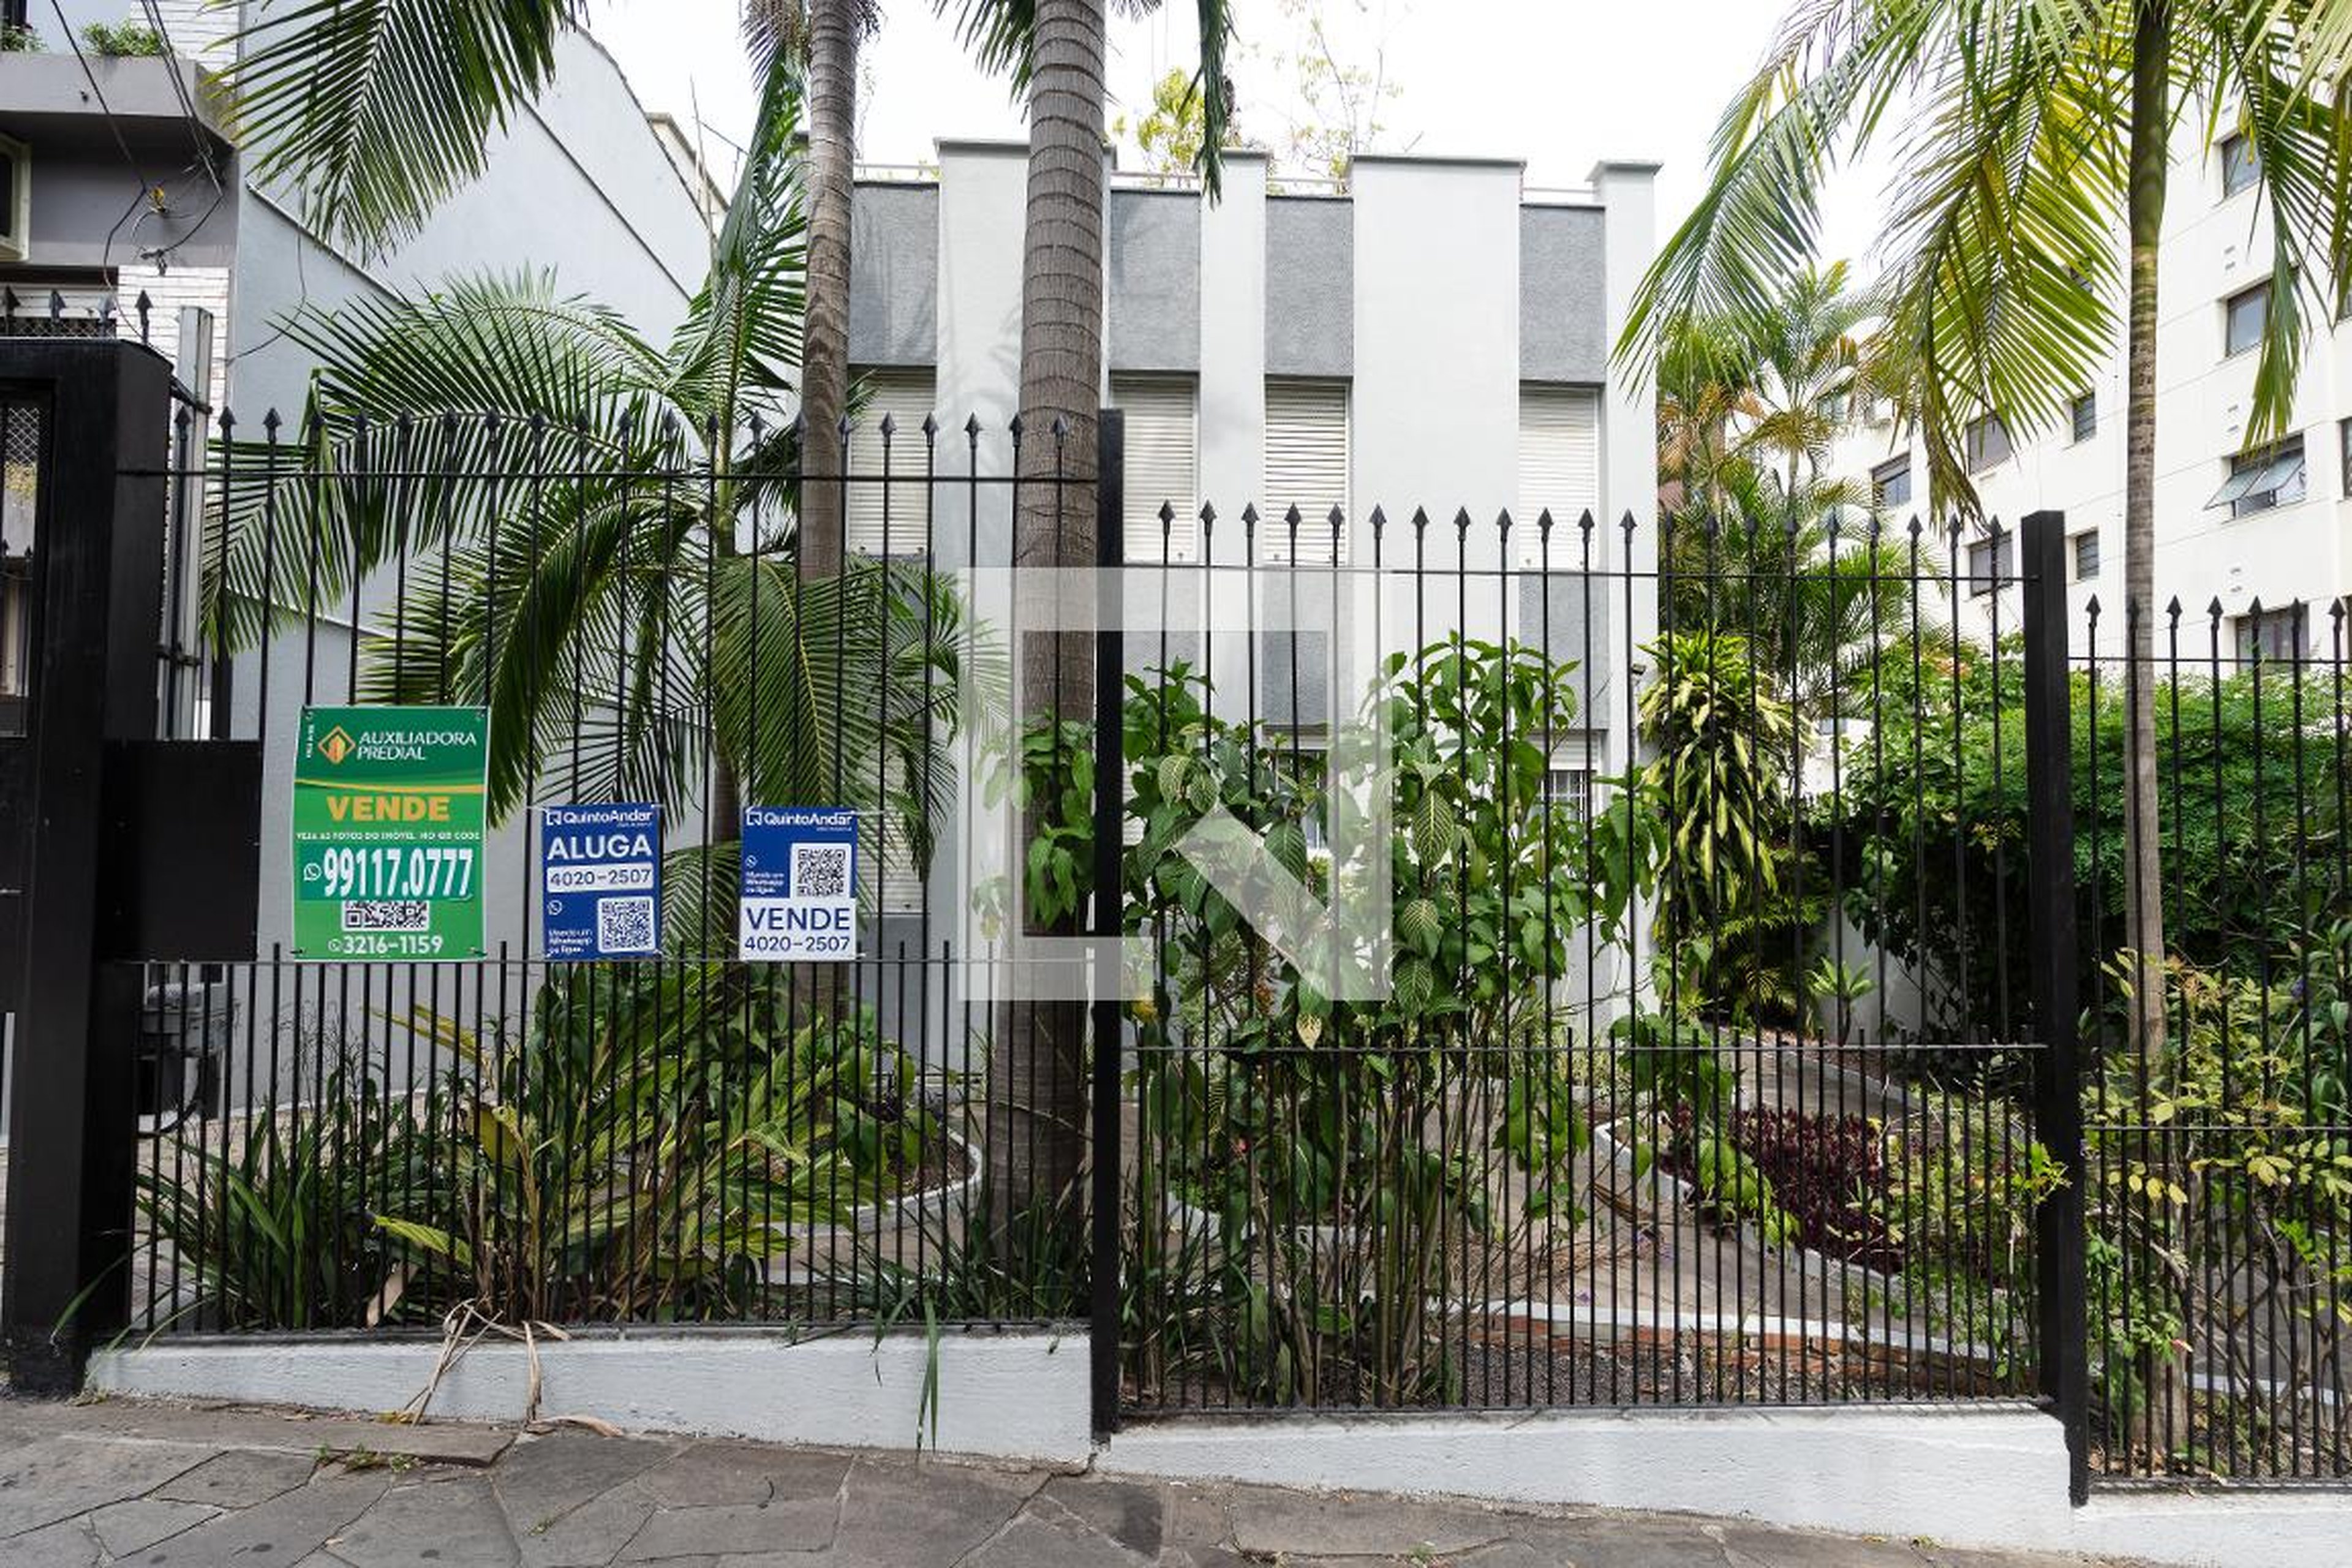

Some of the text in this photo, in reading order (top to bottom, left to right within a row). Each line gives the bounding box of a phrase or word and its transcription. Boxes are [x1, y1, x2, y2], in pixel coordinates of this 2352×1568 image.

[358, 731, 477, 746] AUXILIADORA
[356, 746, 426, 761] PREDIAL
[326, 796, 450, 821] VENDE
[564, 809, 652, 823] QuintoAndar
[764, 813, 853, 826] QuintoAndar
[547, 834, 652, 860] ALUGA
[324, 847, 473, 897] 99117.0777
[551, 869, 652, 887] 4020-2507
[746, 907, 850, 930] VENDE
[343, 935, 443, 954] 3216-1159
[744, 936, 850, 951] 4020-2507
